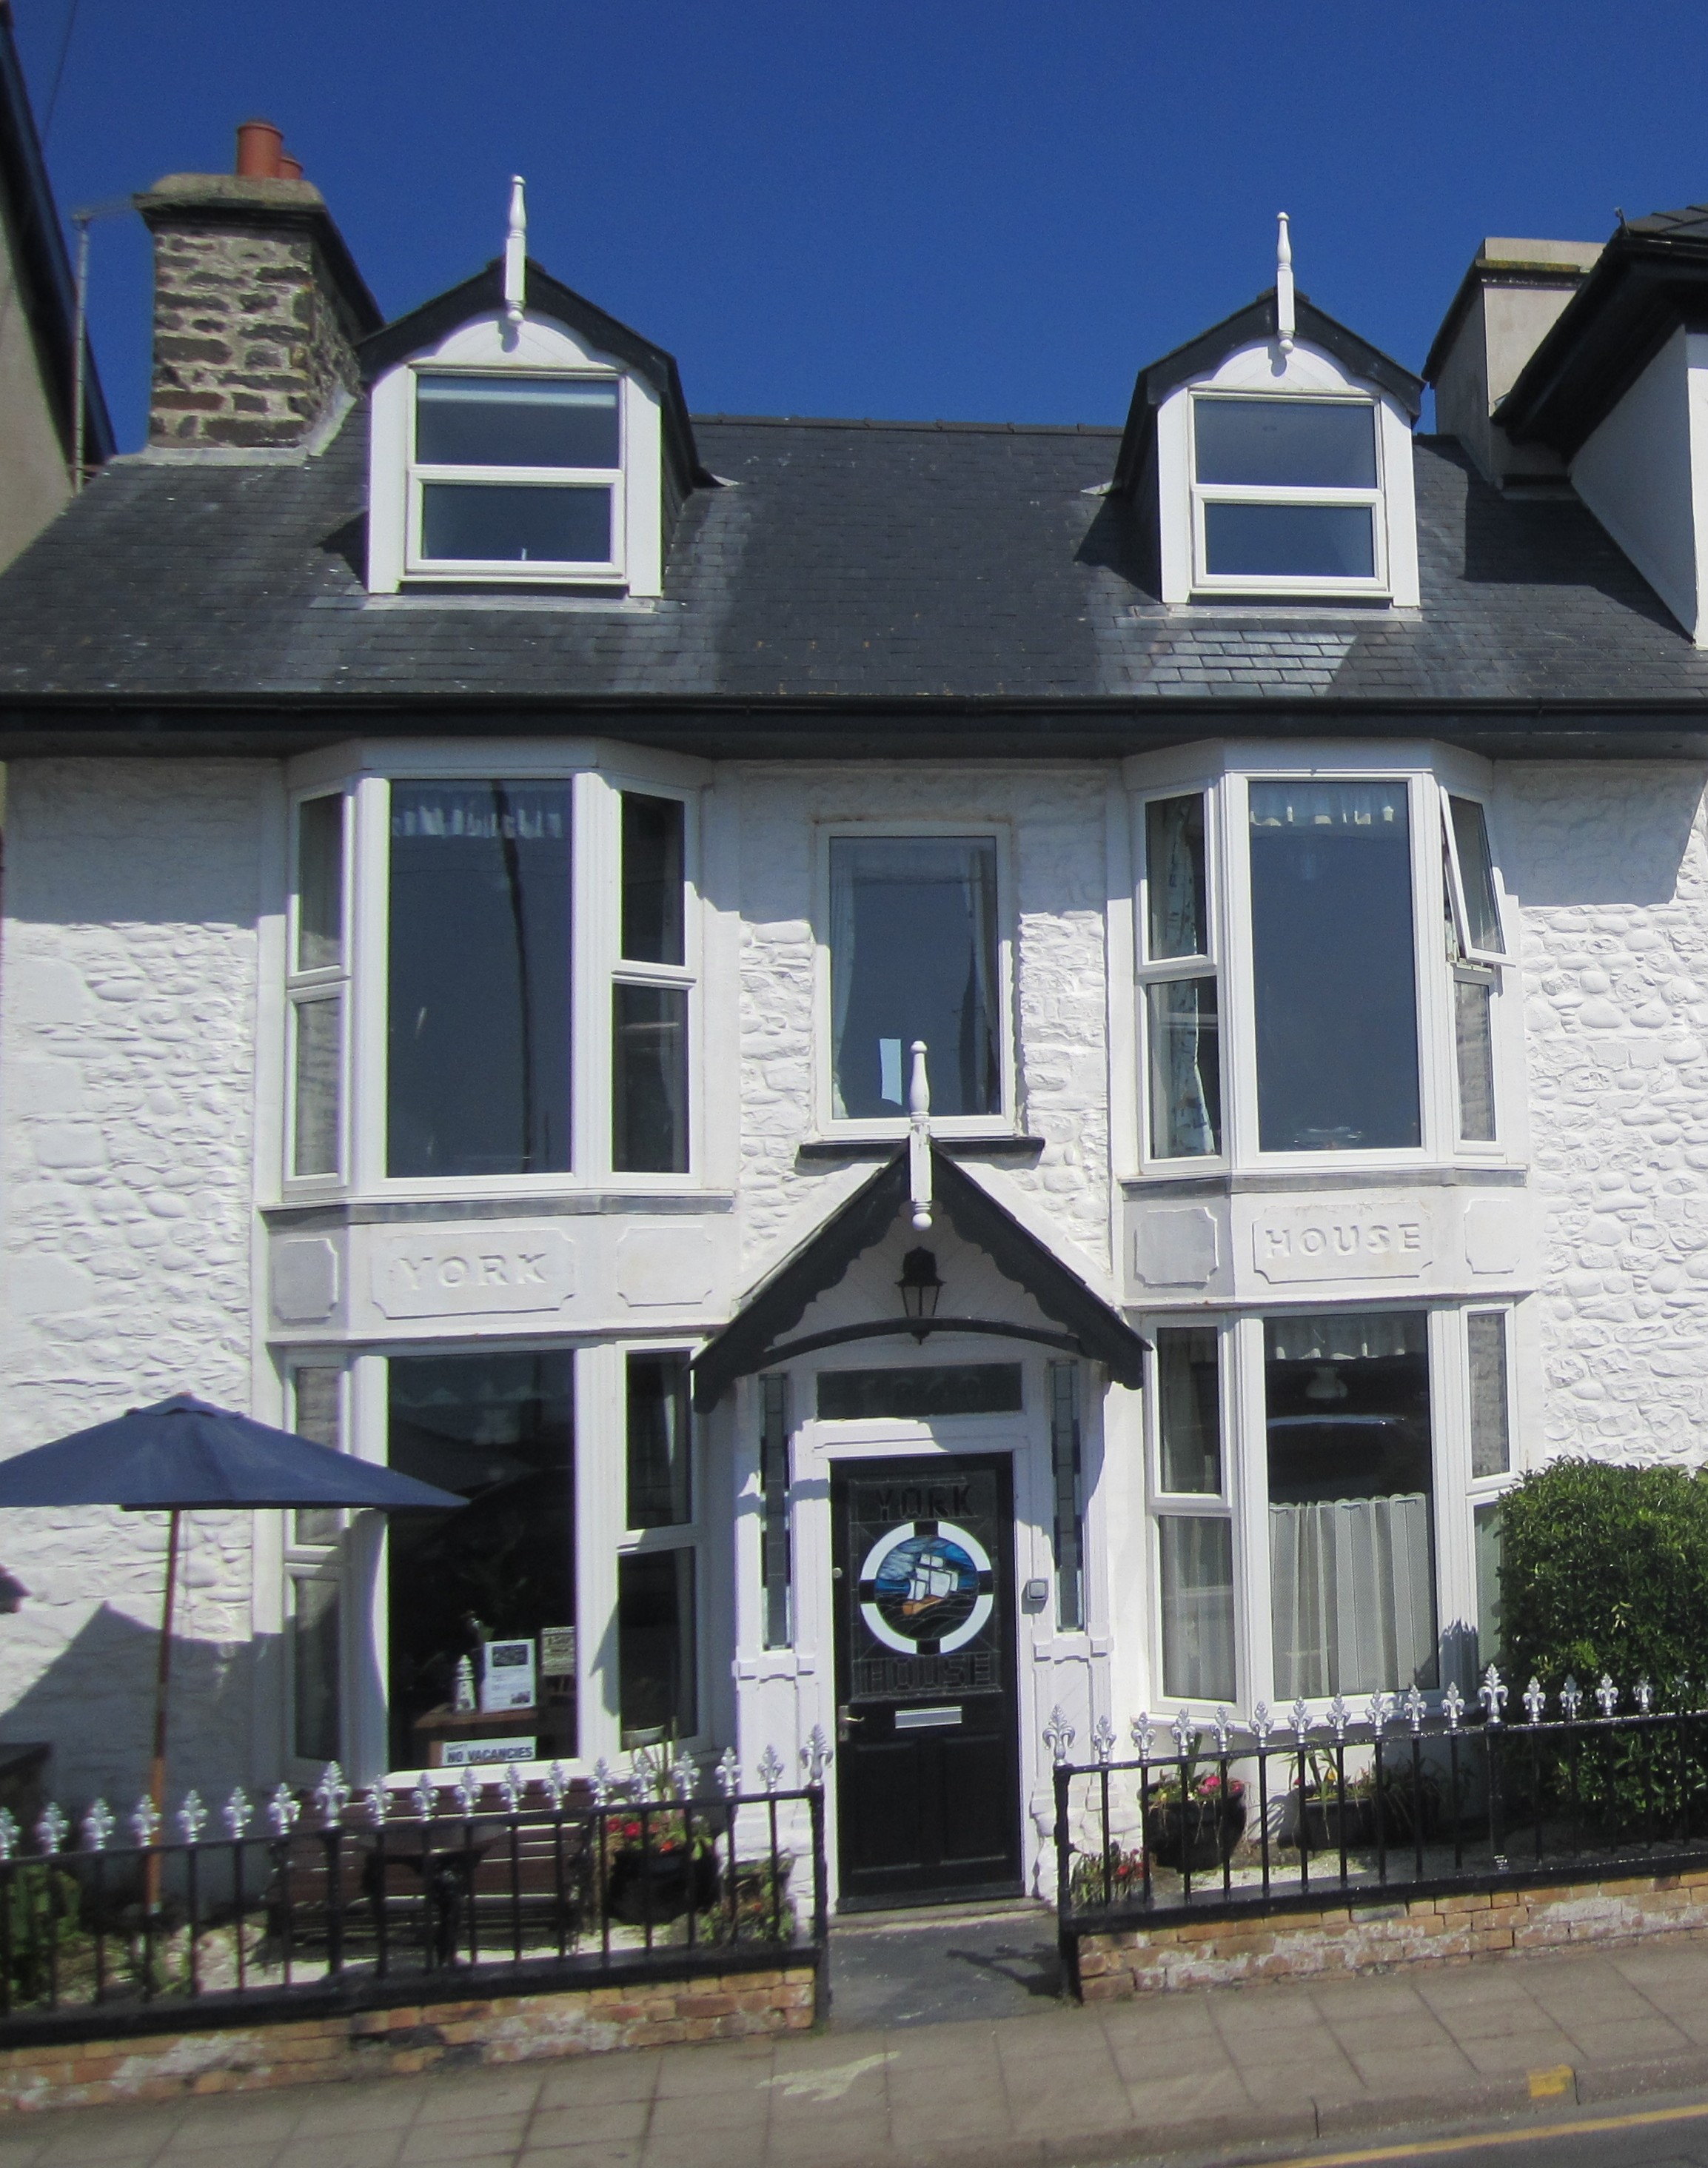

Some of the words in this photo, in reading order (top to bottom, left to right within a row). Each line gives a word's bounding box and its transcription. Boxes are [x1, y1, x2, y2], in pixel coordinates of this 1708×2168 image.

[1265, 1223, 1421, 1259] HOUSE
[398, 1253, 547, 1291] YORK
[875, 1485, 974, 1521] YORK
[865, 1653, 991, 1693] HOUSE
[446, 1750, 463, 1763] NO
[468, 1747, 533, 1762] VACANCIES
